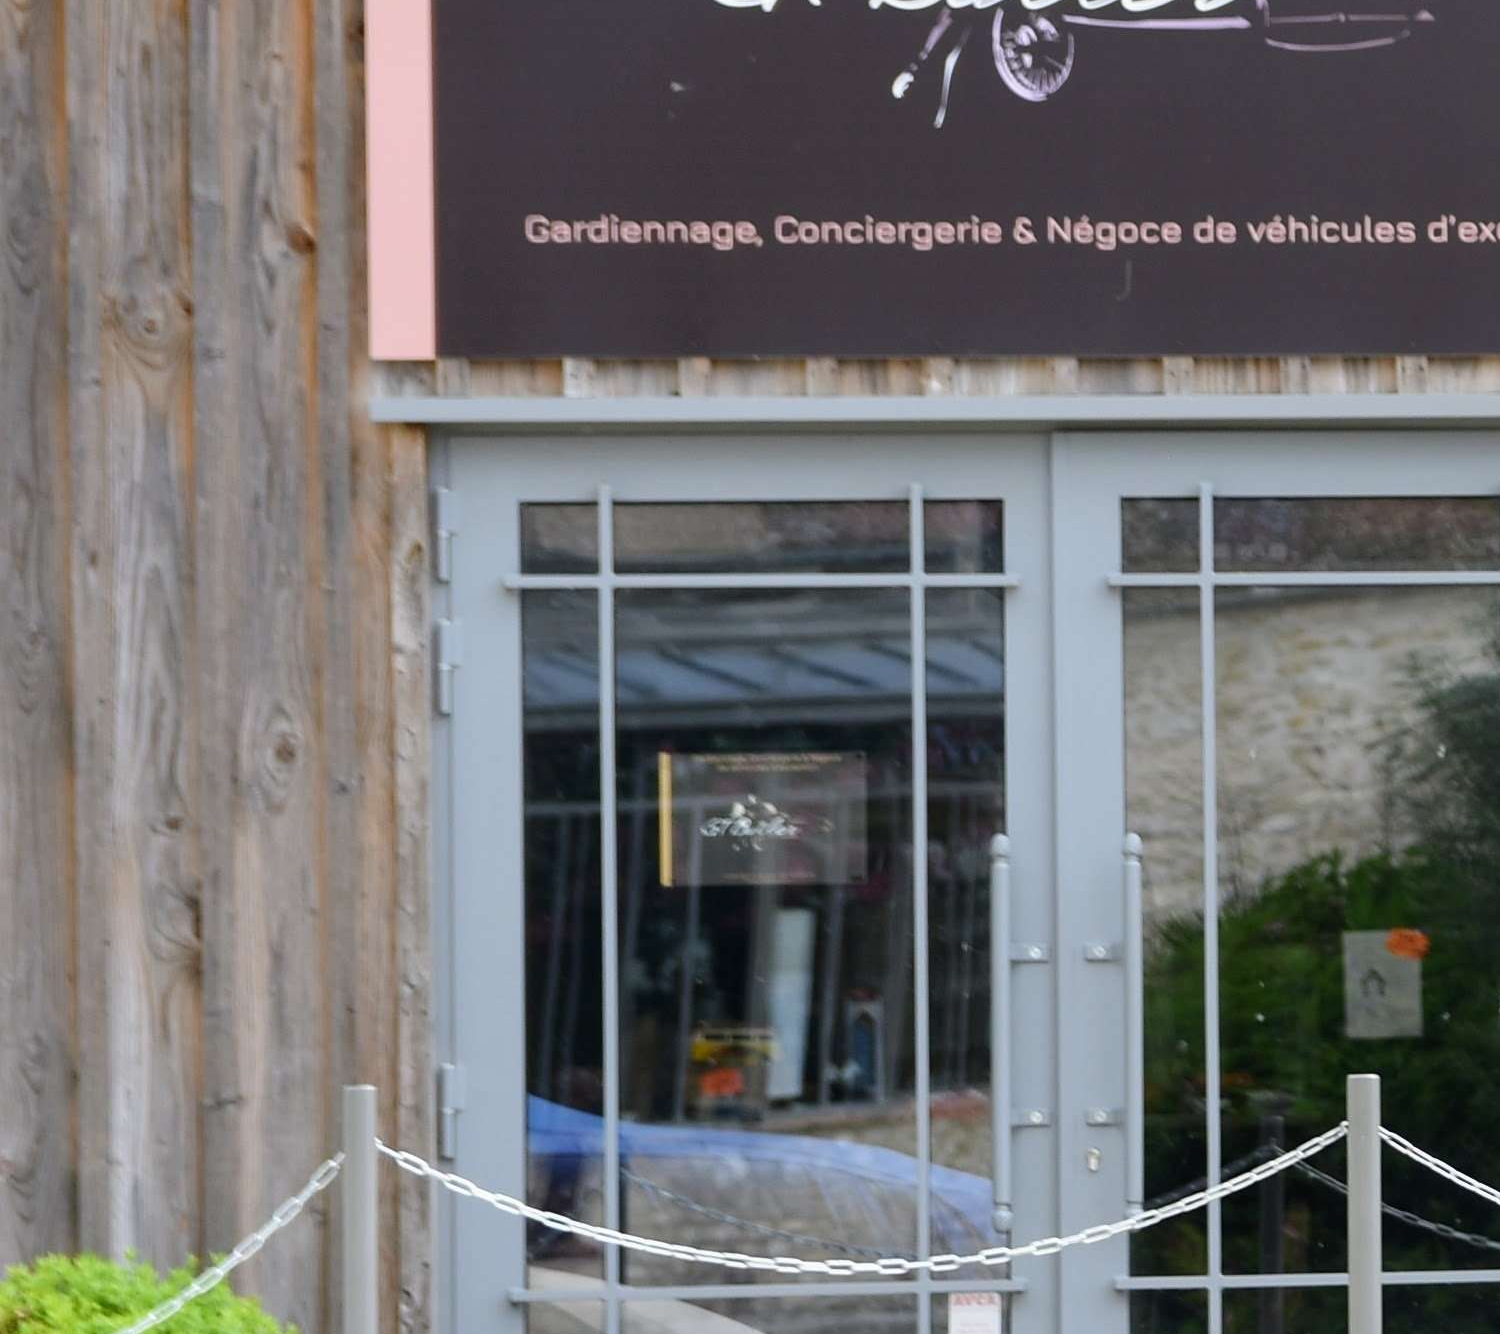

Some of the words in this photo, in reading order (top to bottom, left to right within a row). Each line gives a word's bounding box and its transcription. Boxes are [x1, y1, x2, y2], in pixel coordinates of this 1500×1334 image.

[524, 213, 764, 250] Gardiennage,
[773, 213, 1003, 251] Conciergerie
[1012, 215, 1038, 244] &
[1045, 214, 1183, 250] Négoce
[1193, 215, 1237, 244] de
[1246, 213, 1417, 244] véhicules
